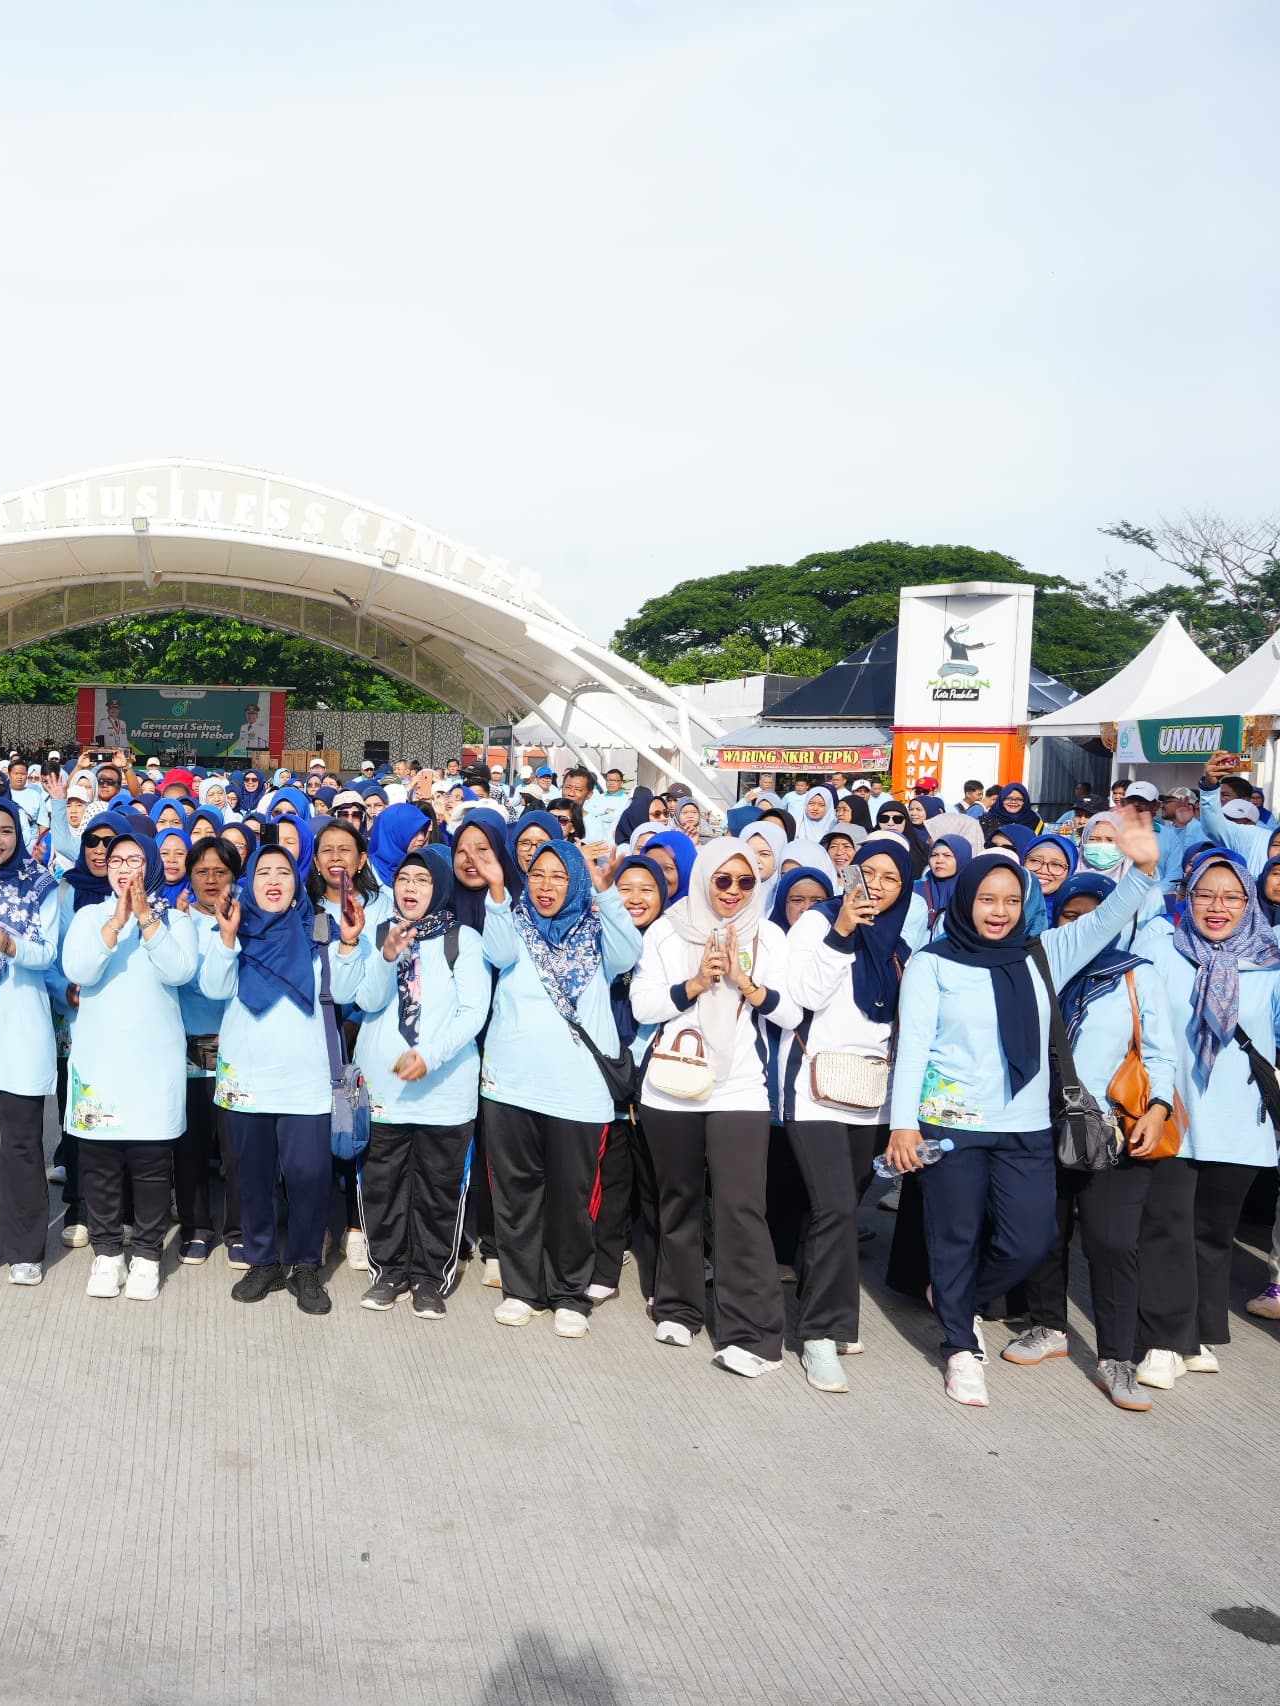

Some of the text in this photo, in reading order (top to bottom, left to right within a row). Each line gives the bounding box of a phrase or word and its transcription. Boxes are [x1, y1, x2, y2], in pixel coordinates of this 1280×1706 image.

[65, 482, 327, 535] BUSINESS
[927, 679, 991, 689] MADIUN
[141, 722, 188, 731] Generasi
[131, 730, 234, 740] Masa Depan Hebat
[1159, 726, 1223, 753] UMKM
[723, 750, 777, 763] WARUNG
[778, 750, 815, 764] NKRI
[905, 738, 919, 804] WARUN
